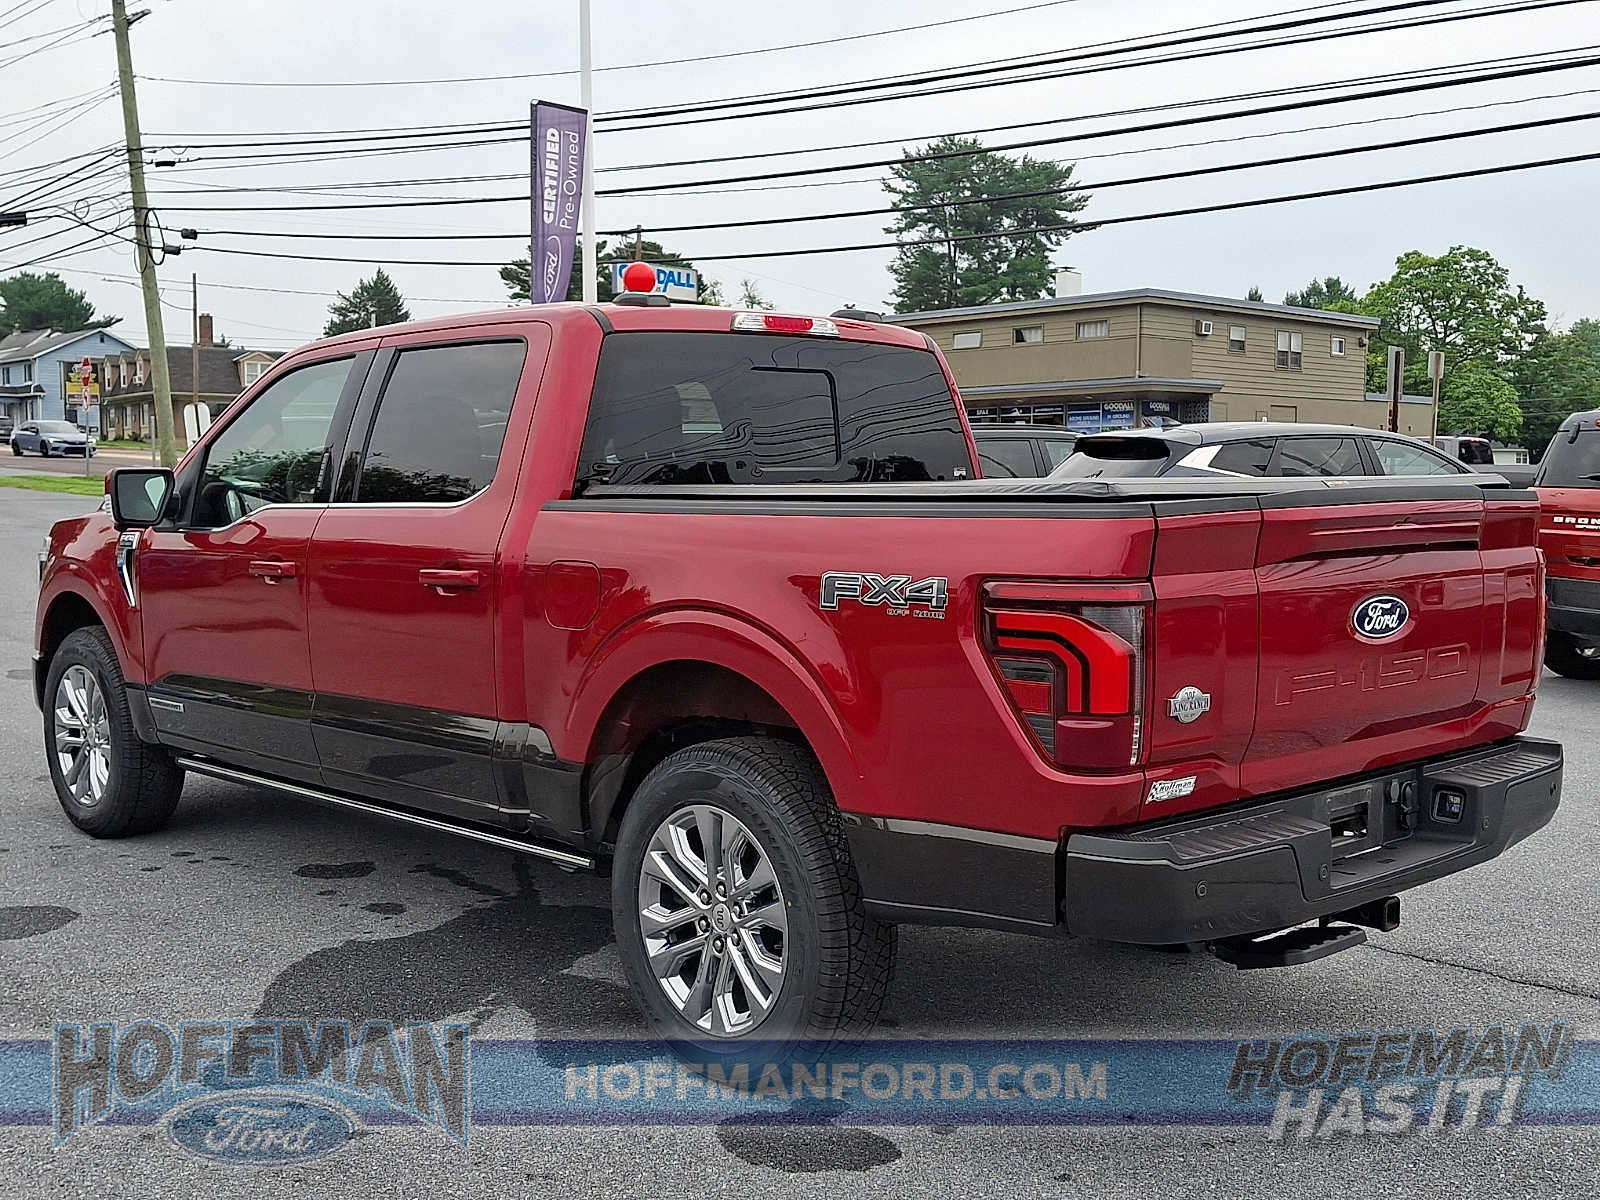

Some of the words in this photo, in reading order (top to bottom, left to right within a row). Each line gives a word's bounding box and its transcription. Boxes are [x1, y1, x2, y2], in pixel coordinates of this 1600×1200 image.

[543, 127, 560, 225] CERTIFIED
[559, 130, 579, 230] Pre-Owned
[1103, 402, 1134, 411] GOODALL
[819, 571, 949, 611] FX4
[1363, 602, 1402, 633] Ford
[1275, 642, 1472, 706] F-150
[1173, 701, 1189, 713] KING
[1189, 696, 1209, 711] RANCH
